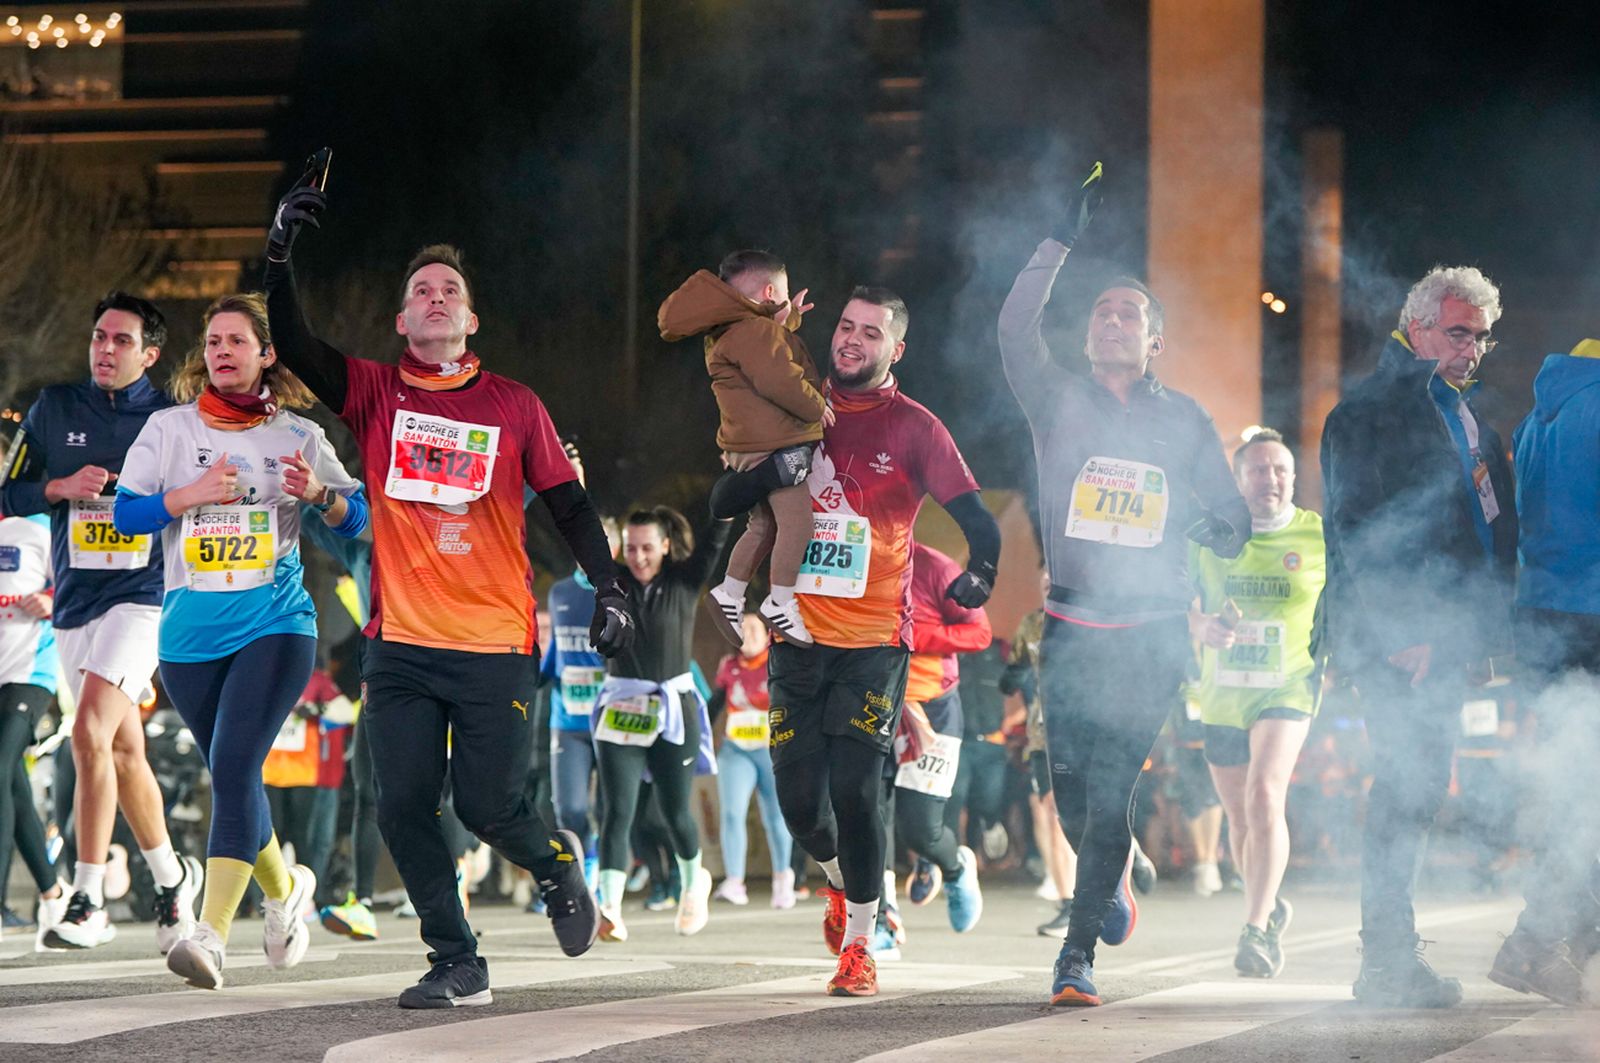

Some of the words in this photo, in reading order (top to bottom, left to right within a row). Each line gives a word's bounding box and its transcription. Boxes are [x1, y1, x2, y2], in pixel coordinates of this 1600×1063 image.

[403, 431, 422, 442] SAN
[425, 437, 458, 448] ANTÓN
[417, 425, 446, 436] NOCHE
[447, 430, 459, 439] DE
[1097, 466, 1125, 478] NOCHE
[1126, 470, 1137, 479] DE
[1084, 474, 1104, 485] SAN
[1105, 478, 1136, 490] ANTÓN
[818, 486, 842, 509] 43
[1095, 487, 1145, 518] 7174
[200, 514, 228, 525] NOCHE
[229, 514, 240, 524] DE
[814, 521, 827, 531] CHE
[828, 522, 839, 531] DE
[192, 526, 207, 537] SAN
[210, 523, 240, 535] ANTÓN
[200, 536, 258, 563] 5722
